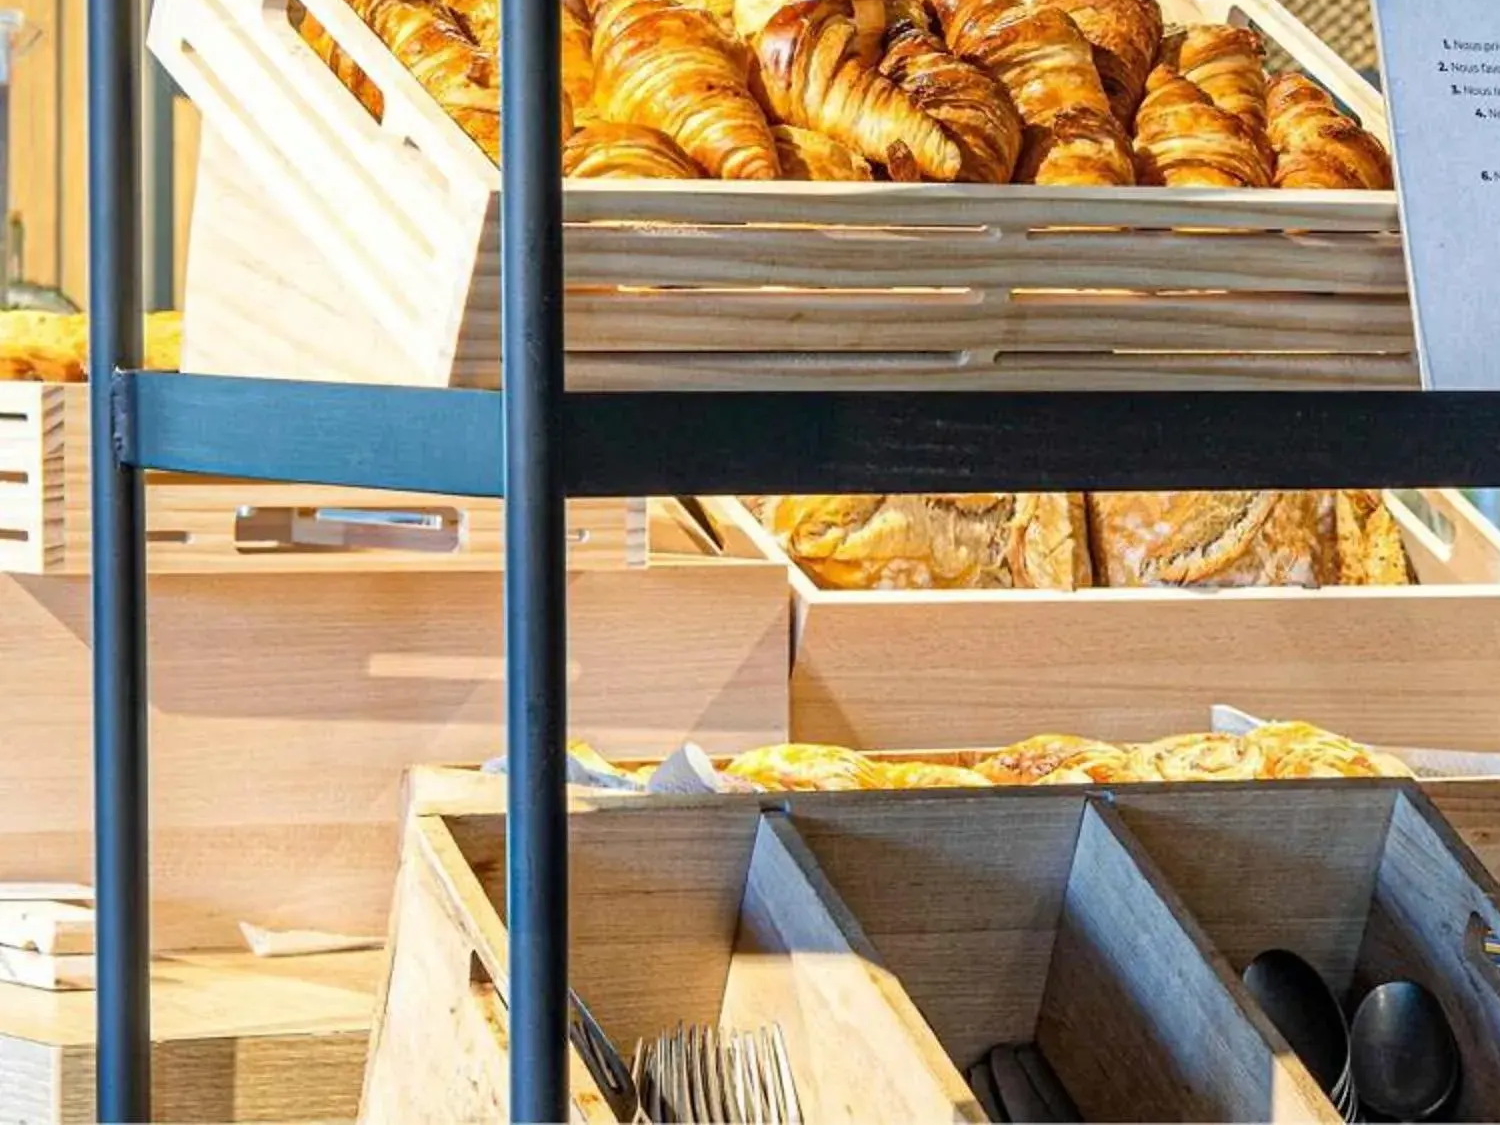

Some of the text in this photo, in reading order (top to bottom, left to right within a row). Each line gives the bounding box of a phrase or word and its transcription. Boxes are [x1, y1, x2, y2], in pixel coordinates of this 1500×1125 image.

[1453, 40, 1482, 52] Nous
[1438, 62, 1448, 72] 2.
[1451, 62, 1479, 74] Nous
[1463, 85, 1491, 96] Nous
[1475, 108, 1487, 118] 4.
[1481, 171, 1492, 181] 6.
